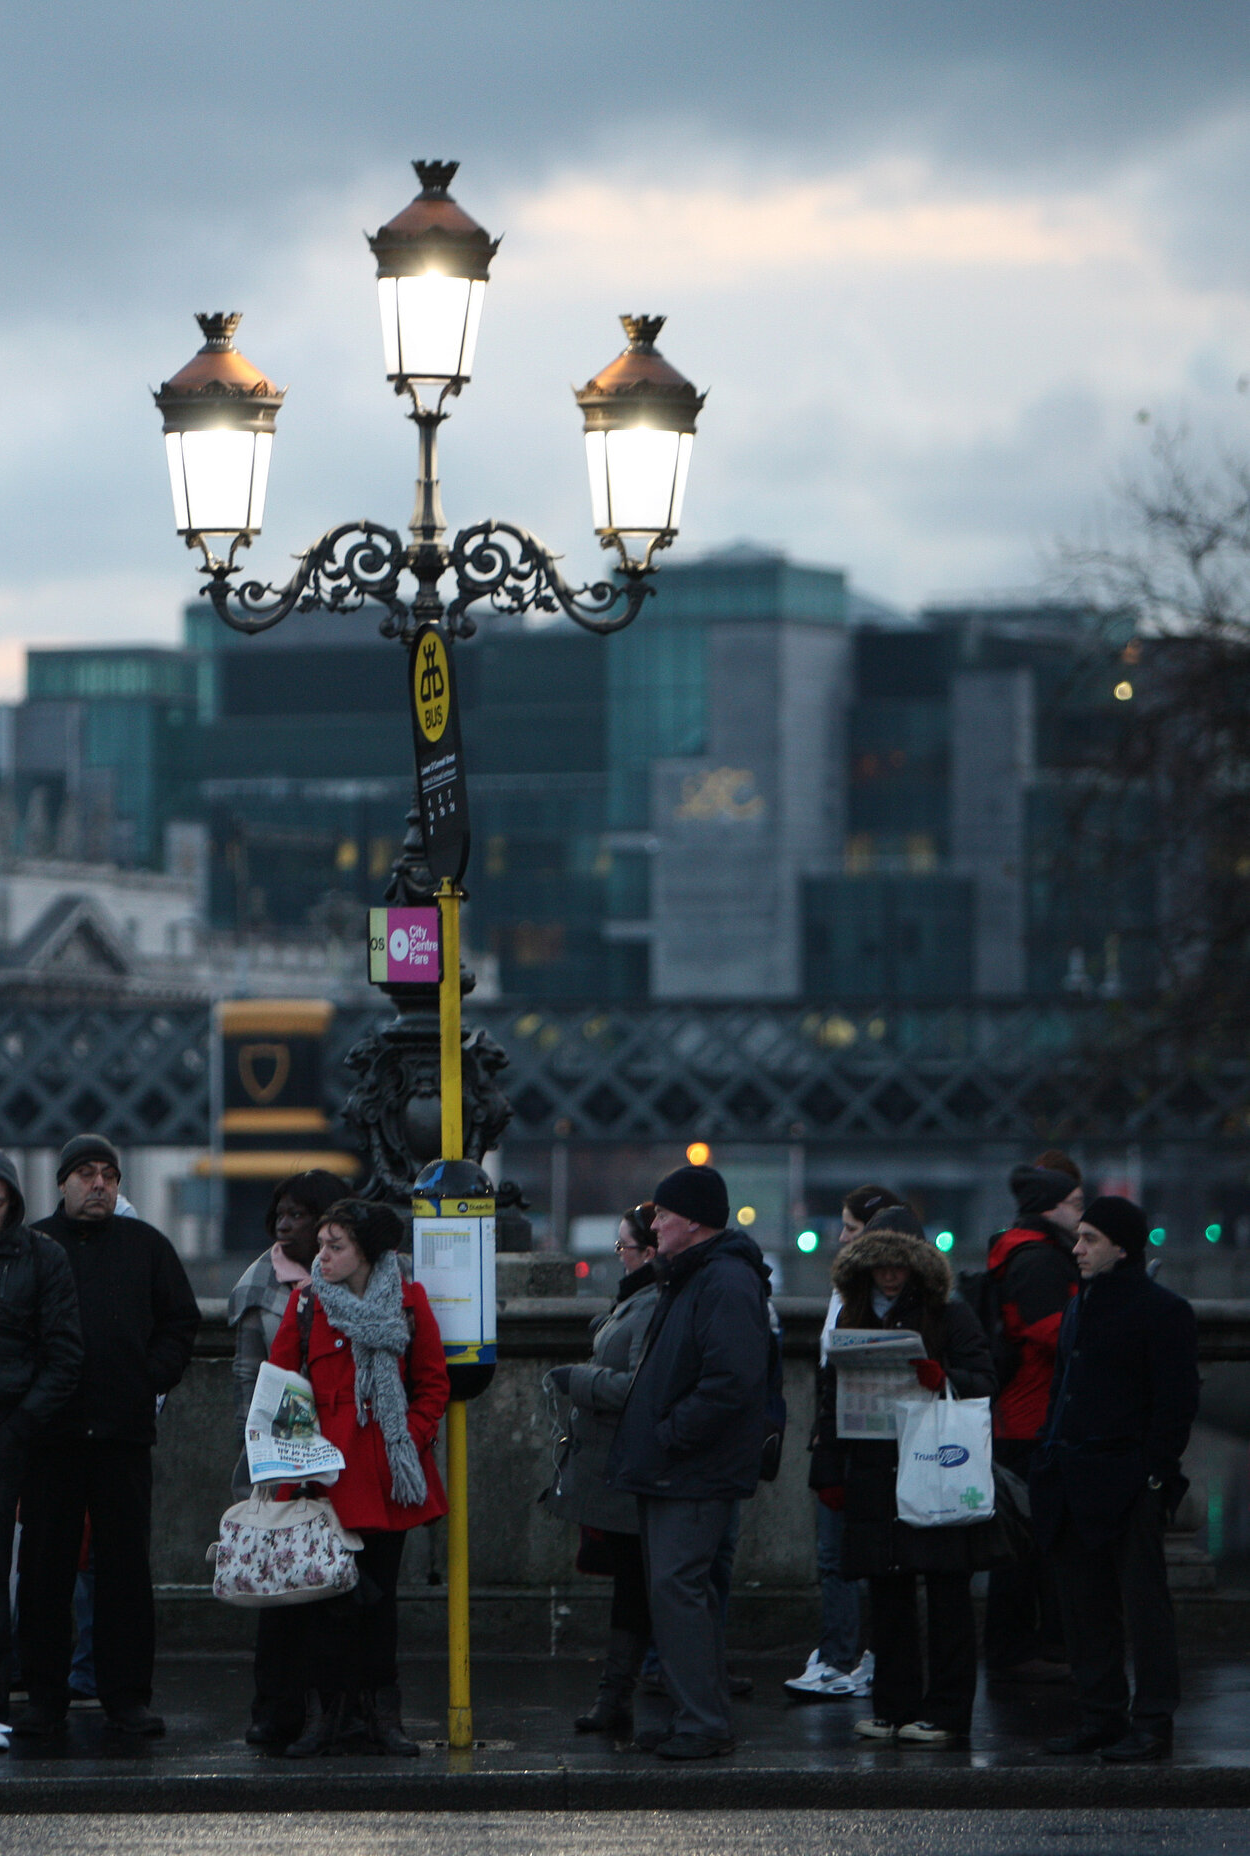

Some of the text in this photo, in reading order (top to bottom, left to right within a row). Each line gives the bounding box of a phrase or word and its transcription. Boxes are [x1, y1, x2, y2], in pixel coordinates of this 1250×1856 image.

[425, 705, 443, 730] BUS
[410, 925, 428, 940] City
[410, 938, 438, 952] Centre
[410, 952, 429, 965] Fare
[913, 1451, 939, 1462] Trust
